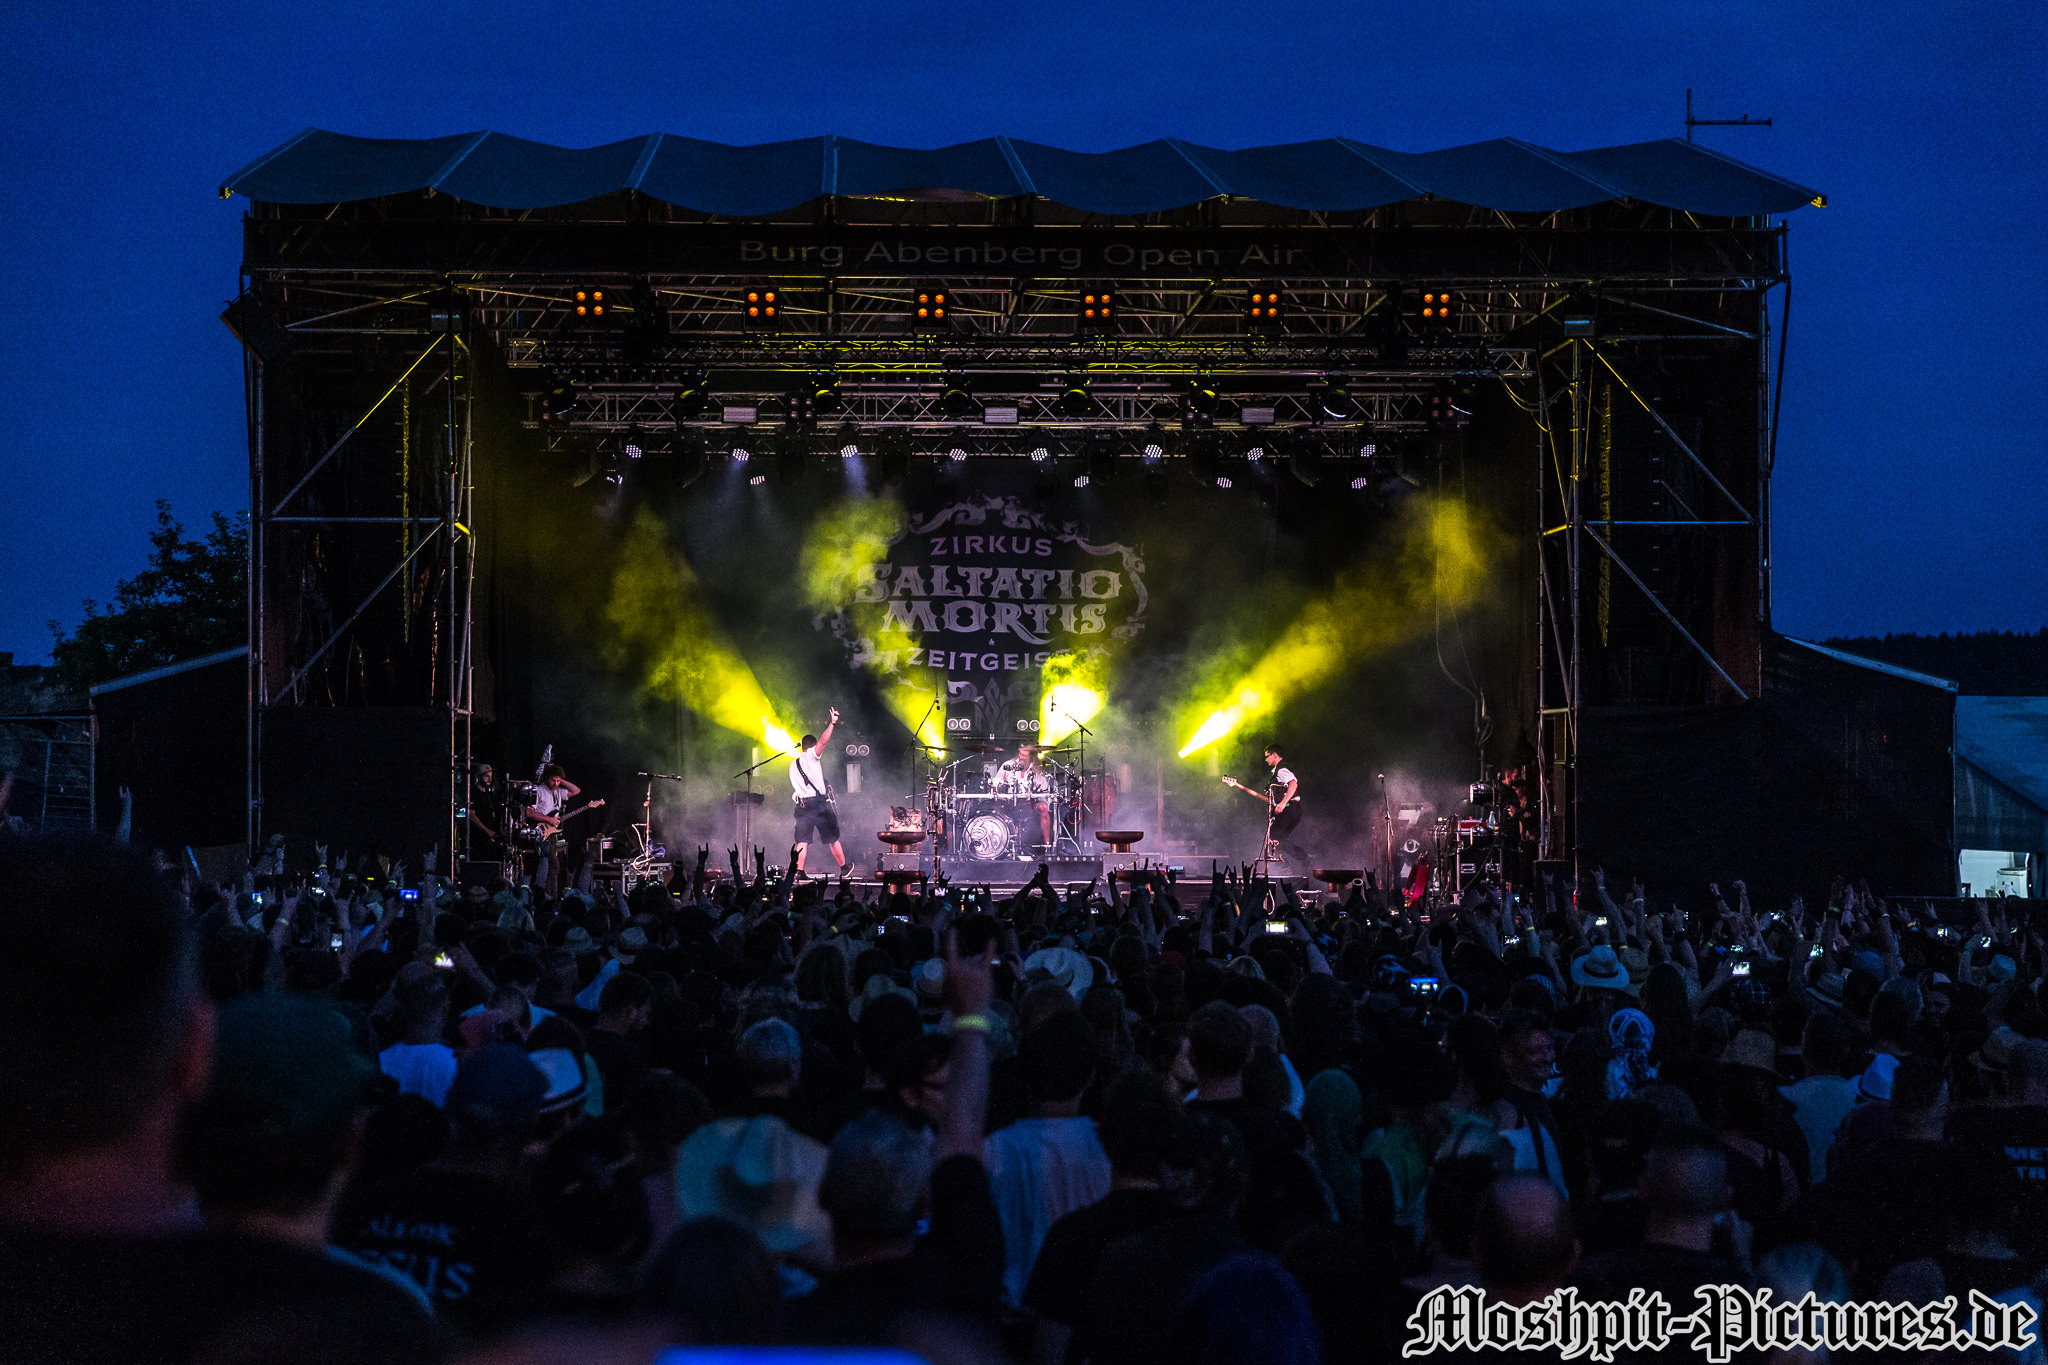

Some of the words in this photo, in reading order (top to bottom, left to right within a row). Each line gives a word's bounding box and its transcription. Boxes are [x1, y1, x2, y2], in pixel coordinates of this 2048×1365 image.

[739, 239, 845, 269] Burg
[863, 240, 1083, 271] Abenberg
[1103, 243, 1221, 272] Open
[1239, 243, 1303, 266] Air
[929, 534, 1054, 557] ZIRKUS
[852, 562, 1123, 604] SALTATIO
[880, 600, 1108, 646] MORTIS
